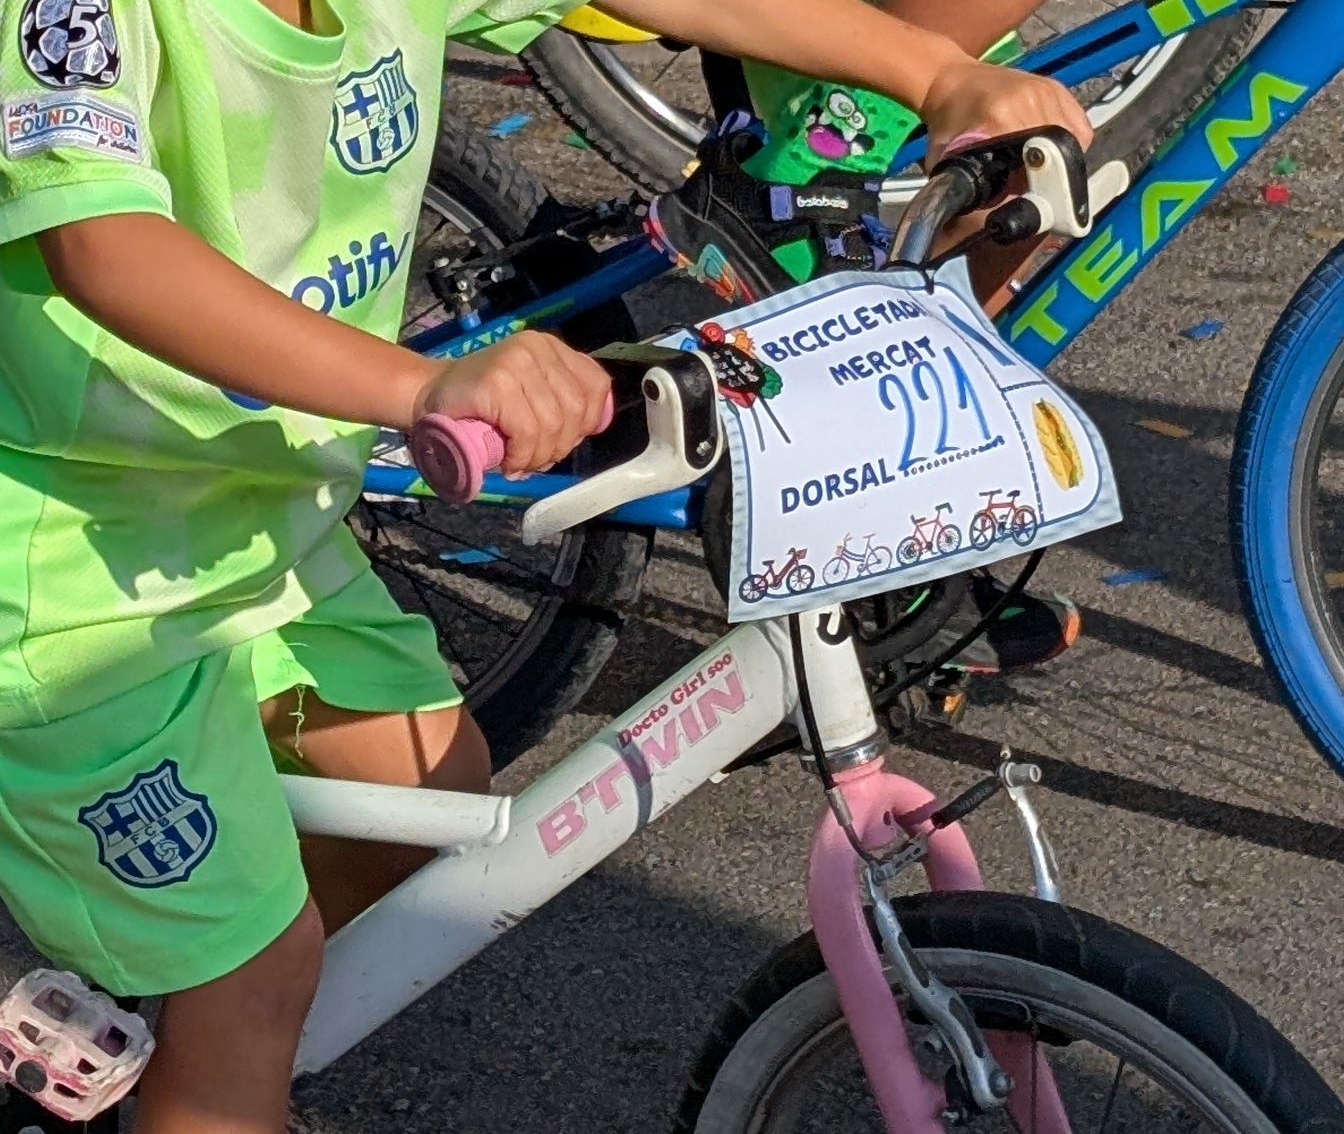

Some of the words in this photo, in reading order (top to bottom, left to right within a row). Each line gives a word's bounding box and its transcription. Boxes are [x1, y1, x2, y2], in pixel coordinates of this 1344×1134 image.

[67, 5, 98, 49] 5
[8, 107, 138, 144] FOUNDATION
[1010, 71, 1309, 346] TEAM
[828, 335, 937, 386] MERCAT
[780, 457, 896, 515] DORSAL
[877, 345, 992, 472] 221
[618, 702, 669, 748] Docto
[669, 670, 708, 706] Girl
[536, 669, 746, 859] B'TWIN
